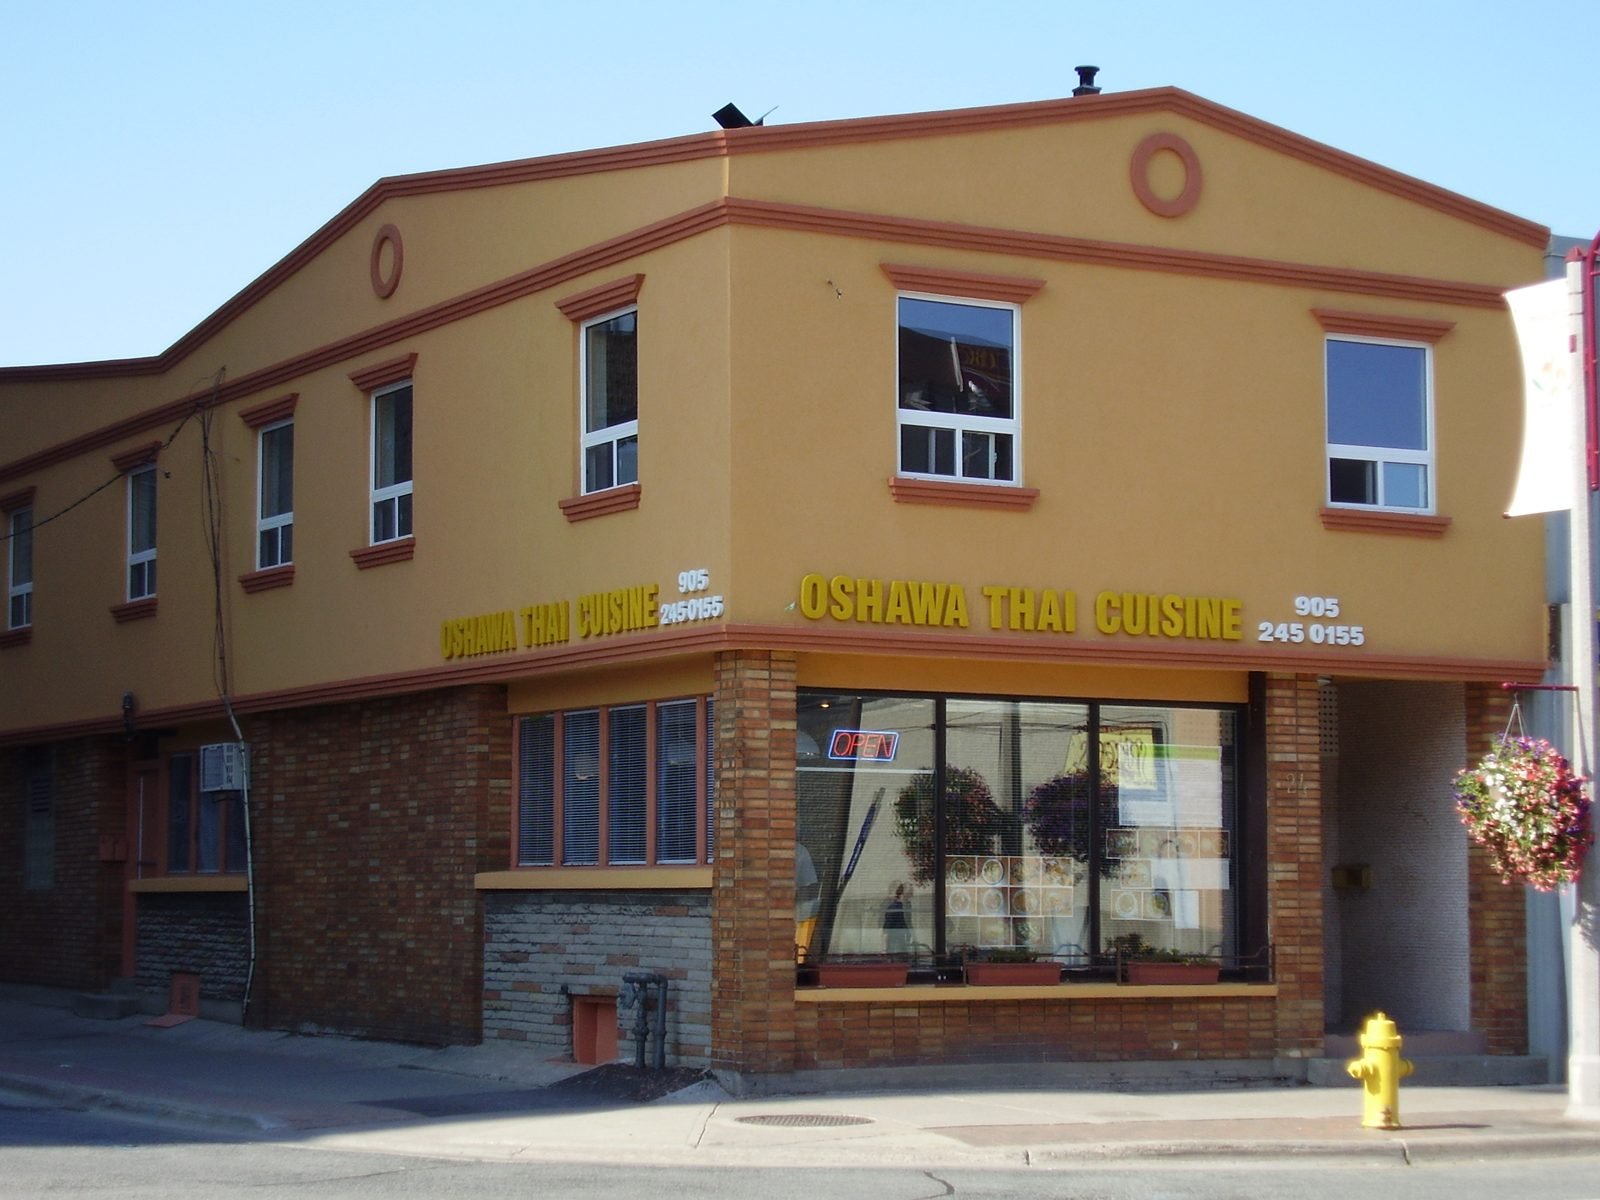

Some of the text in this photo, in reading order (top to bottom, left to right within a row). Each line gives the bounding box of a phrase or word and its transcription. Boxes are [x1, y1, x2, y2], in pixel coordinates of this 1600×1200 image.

[678, 568, 709, 593] 905
[800, 573, 1244, 641] OSHAWA THAI CUISINE
[1294, 596, 1340, 618] 905
[440, 583, 659, 660] OSHAWA THAI CUISINE
[1258, 622, 1365, 646] 245 0155
[834, 733, 895, 758] OPEN
